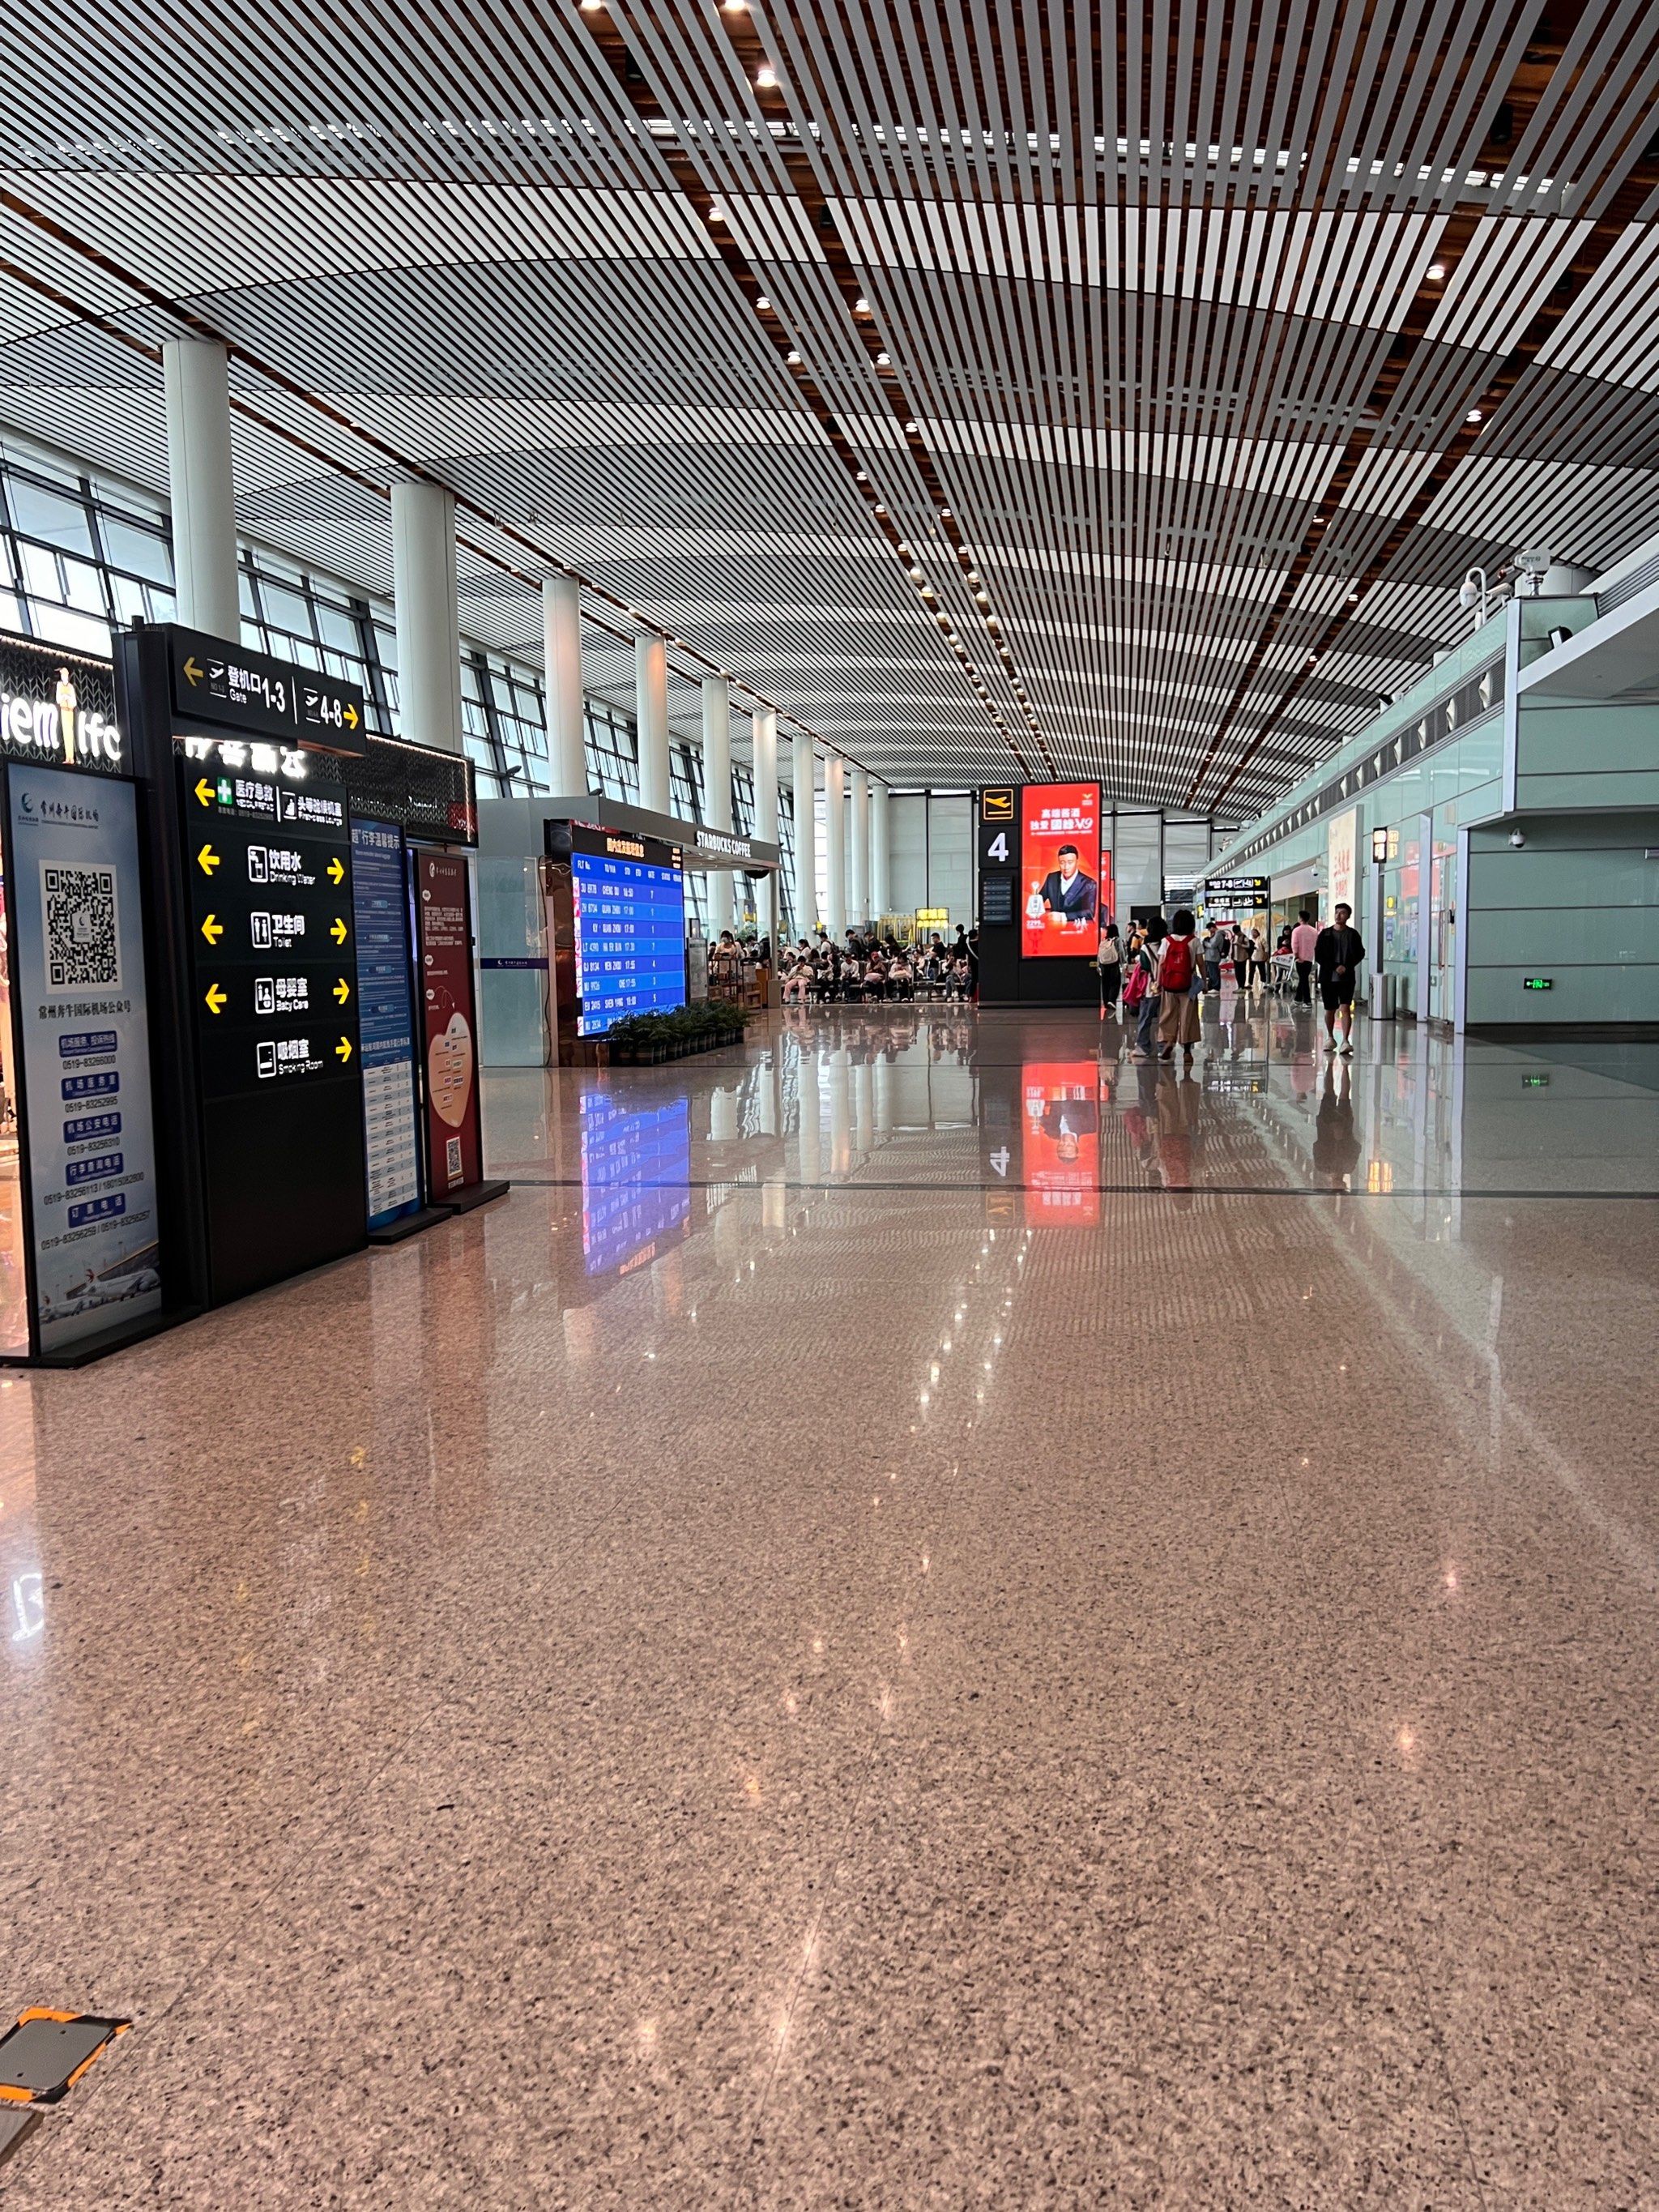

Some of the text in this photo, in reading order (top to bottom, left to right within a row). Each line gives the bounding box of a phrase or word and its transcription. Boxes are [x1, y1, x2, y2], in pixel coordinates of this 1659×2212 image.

[228, 664, 262, 694] 登机口
[229, 688, 247, 704] Gate
[262, 677, 285, 712] 1-3
[320, 695, 343, 728] 4-8
[235, 779, 274, 802] 医疗急救
[697, 831, 751, 858] STARBUCKS COFFEE
[987, 832, 1009, 862] 4
[269, 849, 302, 872] 饮用水
[271, 915, 305, 935] 卫生间
[272, 936, 292, 948] Toilet
[275, 977, 309, 998] 母婴室
[277, 1039, 309, 1060] 吸烟室
